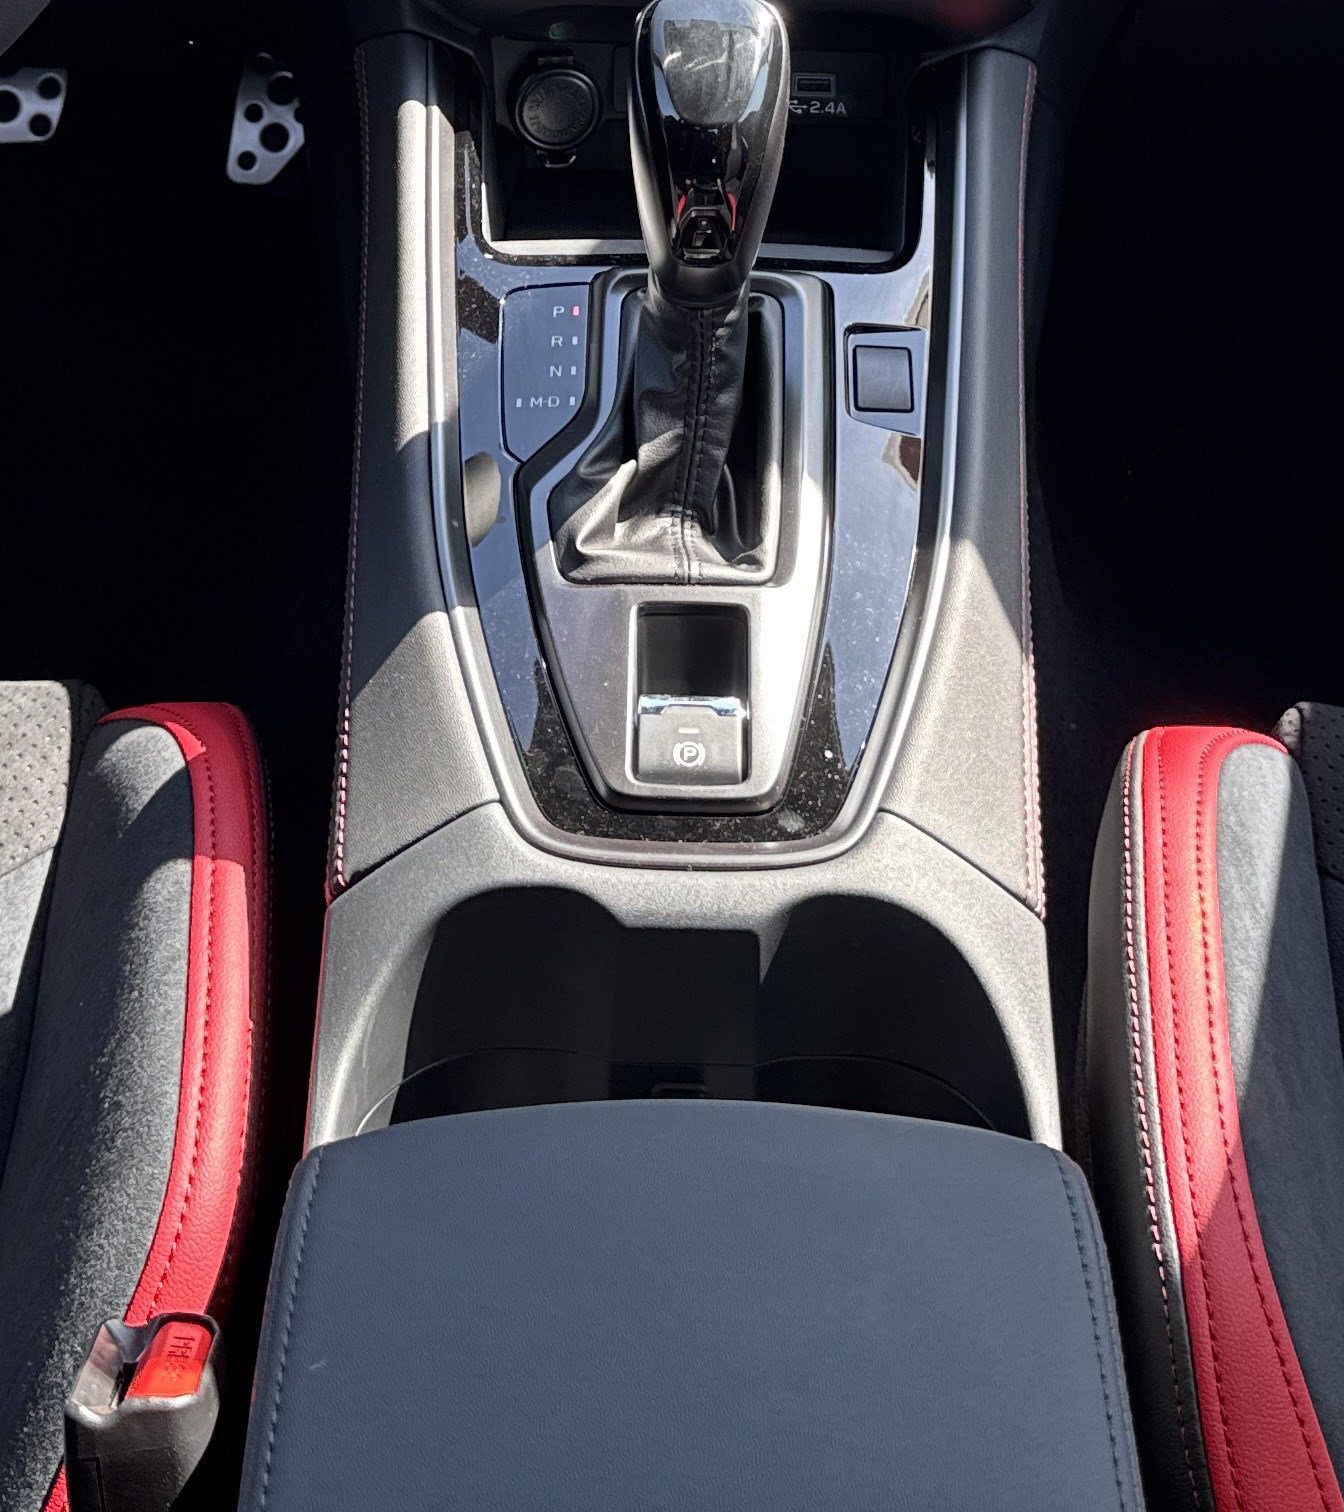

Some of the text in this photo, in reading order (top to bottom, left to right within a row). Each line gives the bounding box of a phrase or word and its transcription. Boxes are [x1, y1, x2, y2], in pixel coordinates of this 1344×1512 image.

[809, 100, 848, 115] 2.4A
[552, 305, 565, 318] P
[550, 334, 564, 348] R
[549, 364, 563, 378] N
